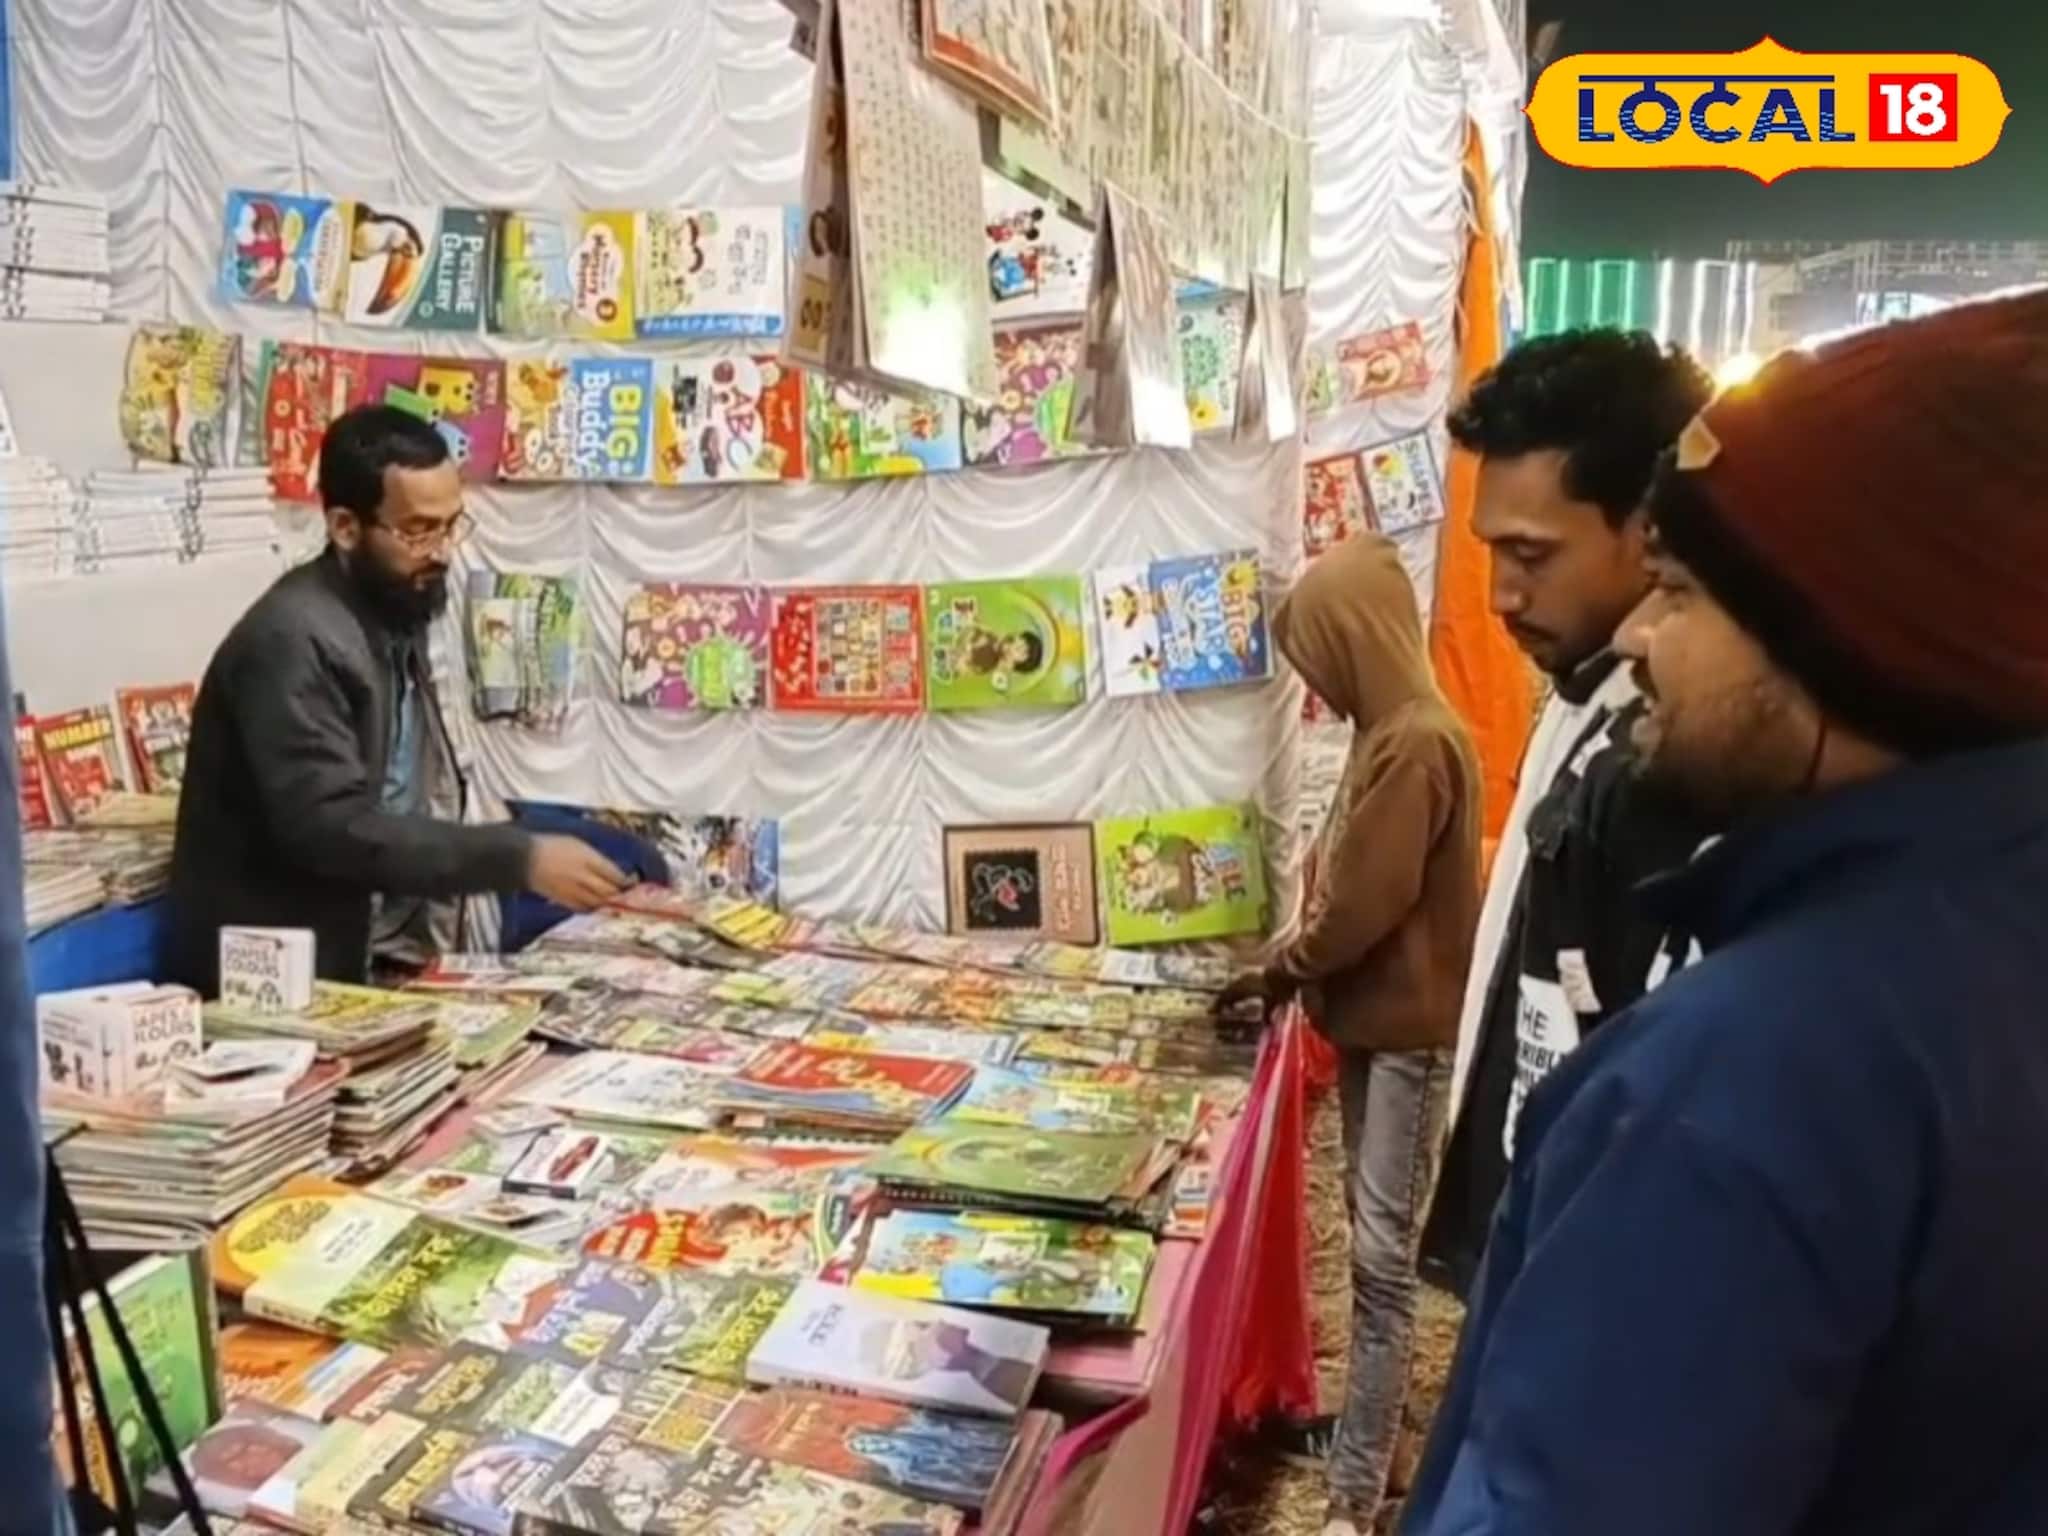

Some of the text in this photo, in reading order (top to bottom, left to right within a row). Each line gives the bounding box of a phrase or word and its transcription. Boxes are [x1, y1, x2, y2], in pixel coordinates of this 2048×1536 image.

[434, 232, 462, 313] GALLERY
[455, 235, 485, 314] PICTURE
[575, 370, 611, 469] Buddy
[605, 384, 643, 461] BIG
[725, 387, 757, 474] ABC
[1196, 588, 1227, 656] STAR
[1220, 590, 1250, 646] BIG
